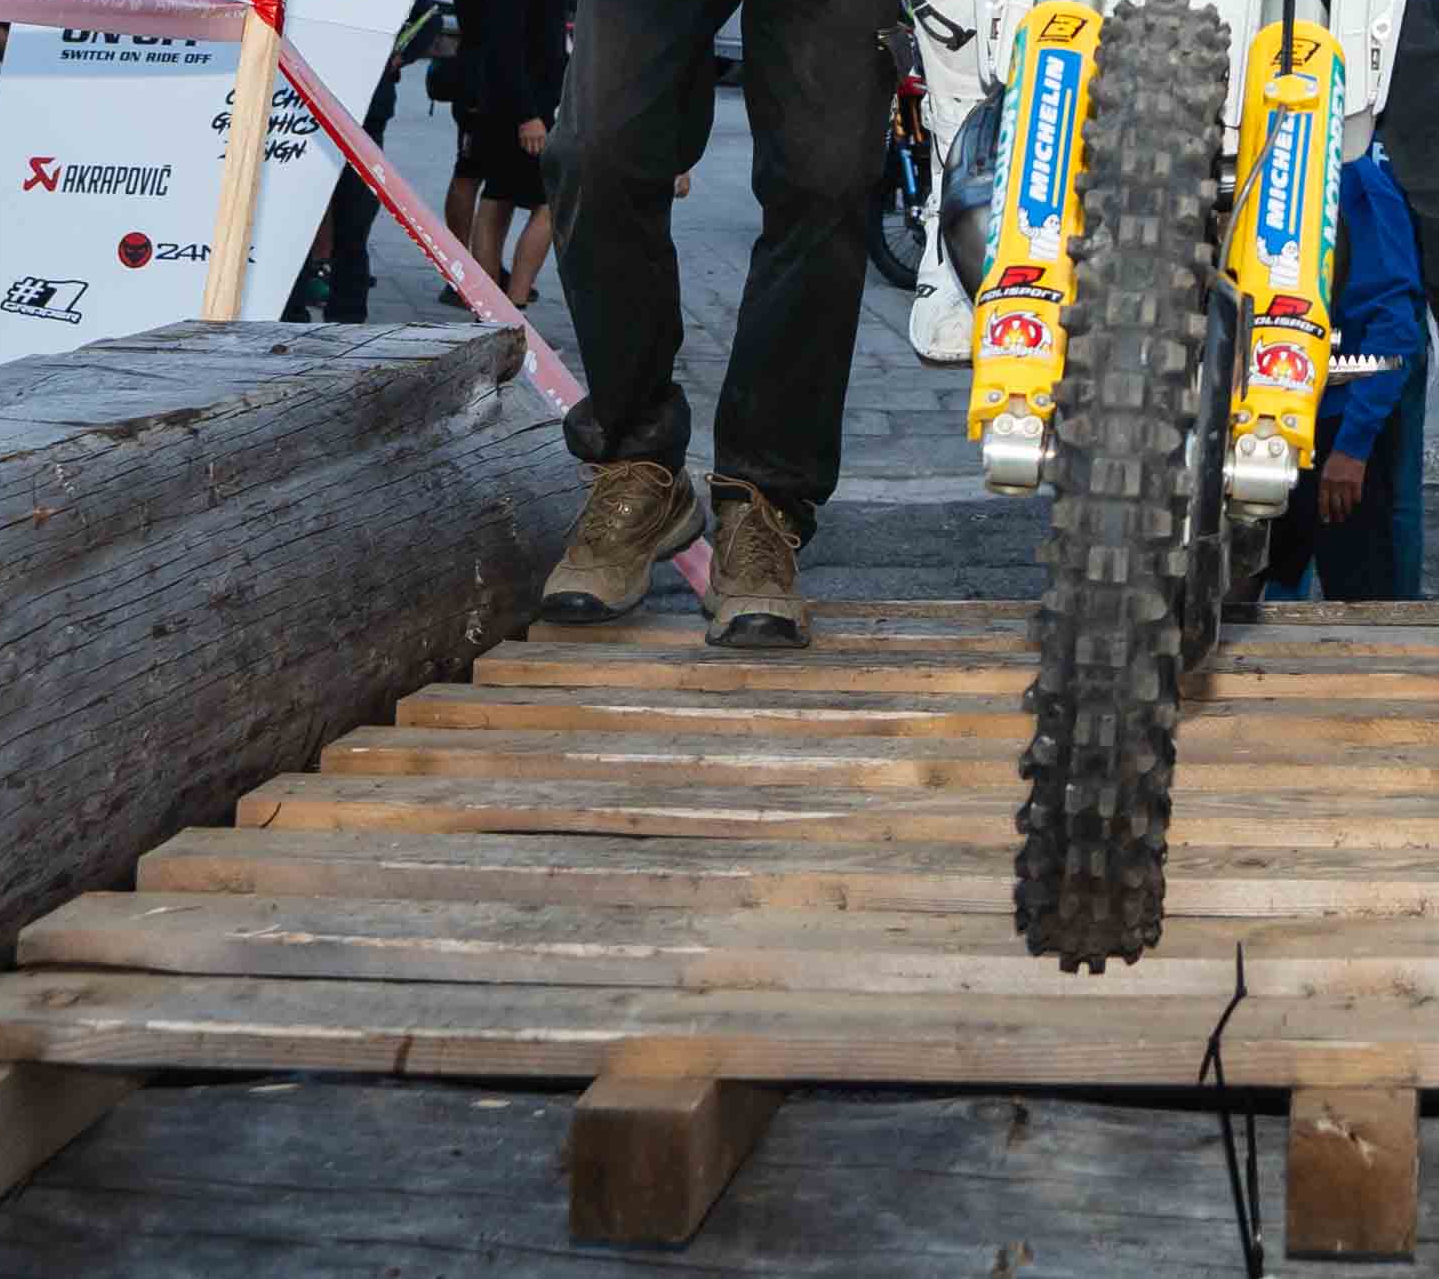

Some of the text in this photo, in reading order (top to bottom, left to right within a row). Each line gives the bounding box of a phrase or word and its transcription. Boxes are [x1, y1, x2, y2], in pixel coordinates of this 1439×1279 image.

[60, 49, 213, 64] SWITCH ON RIDE OFF
[1028, 55, 1066, 203] MICHELIN
[62, 164, 172, 196] AKRAPOVIČ
[1254, 316, 1324, 337] OLISPORT
